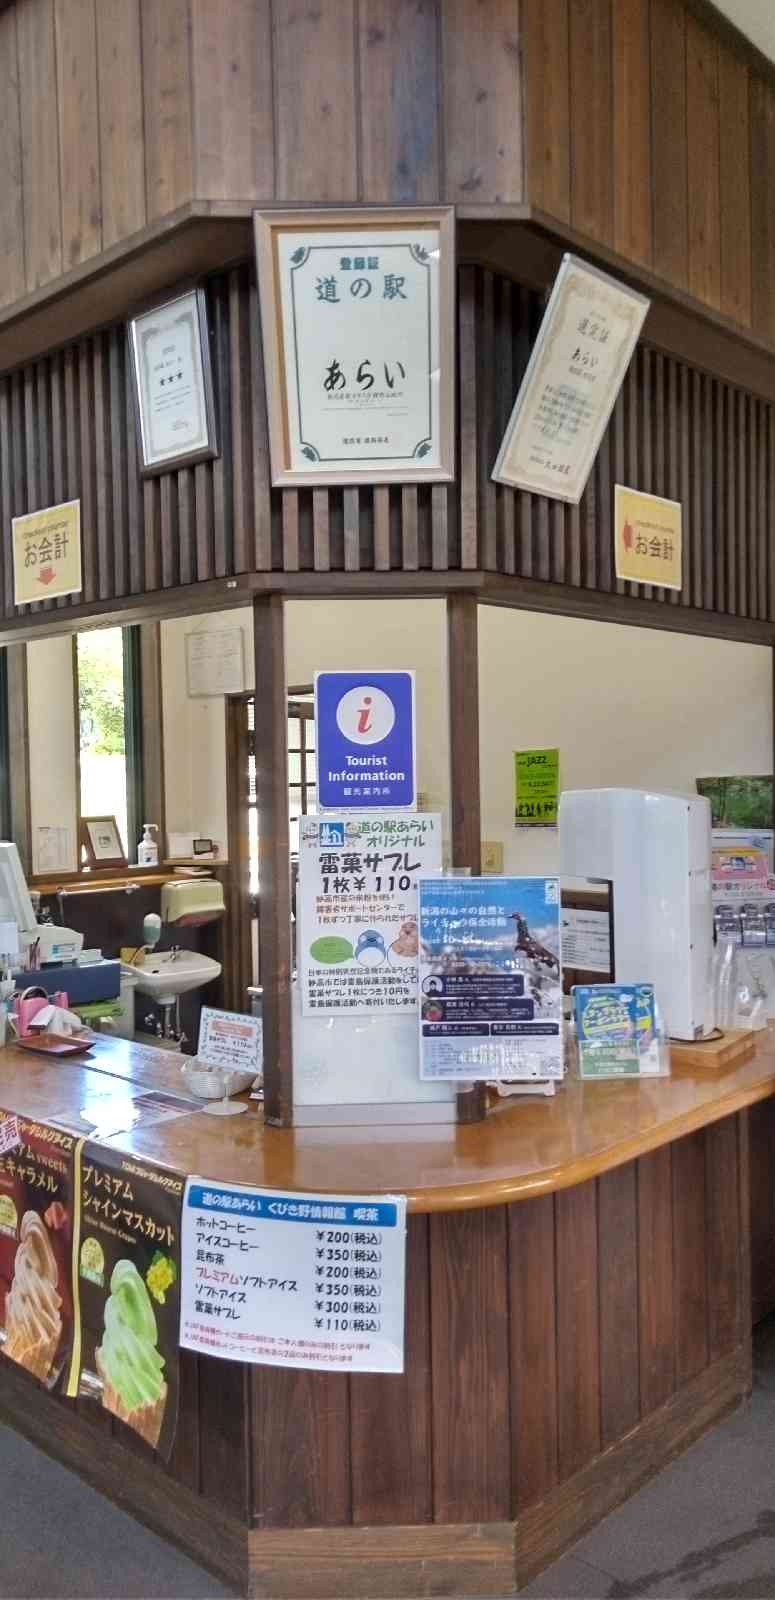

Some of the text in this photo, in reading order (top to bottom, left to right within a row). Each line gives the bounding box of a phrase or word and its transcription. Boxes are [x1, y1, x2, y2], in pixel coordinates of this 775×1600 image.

[314, 273, 408, 304] 道の駅
[323, 358, 406, 391] あらい
[24, 532, 69, 568] お会計
[635, 533, 675, 561] お会計
[345, 755, 388, 767] Tourist
[527, 755, 546, 767] JAZZ
[328, 770, 406, 782] Information
[358, 820, 434, 834] 道の駅あらい
[367, 835, 426, 848] オリジナル
[319, 852, 422, 874] 雷菓サブレ
[82, 1165, 134, 1201] プレミアム
[202, 1191, 379, 1222] 道の駅あらい くびき野情報館 喫茶
[82, 1190, 175, 1247] シャインマスカット
[195, 1217, 256, 1234] ホットコーヒー
[195, 1233, 260, 1251] アイスコーヒー
[315, 1230, 383, 1245] ¥200(税込)
[195, 1249, 225, 1265] 昆布茶
[315, 1248, 382, 1262] ¥350(税込)
[195, 1267, 298, 1292] プレミアムソフトアイス
[315, 1265, 382, 1280] ¥200(税込)
[195, 1283, 247, 1304] ソフトアイス
[315, 1283, 382, 1297] ¥350(税込)
[194, 1300, 241, 1320] 雷菓サブレ
[314, 1300, 381, 1314] ¥300(税込)
[314, 1318, 381, 1332] ¥110(税込)
